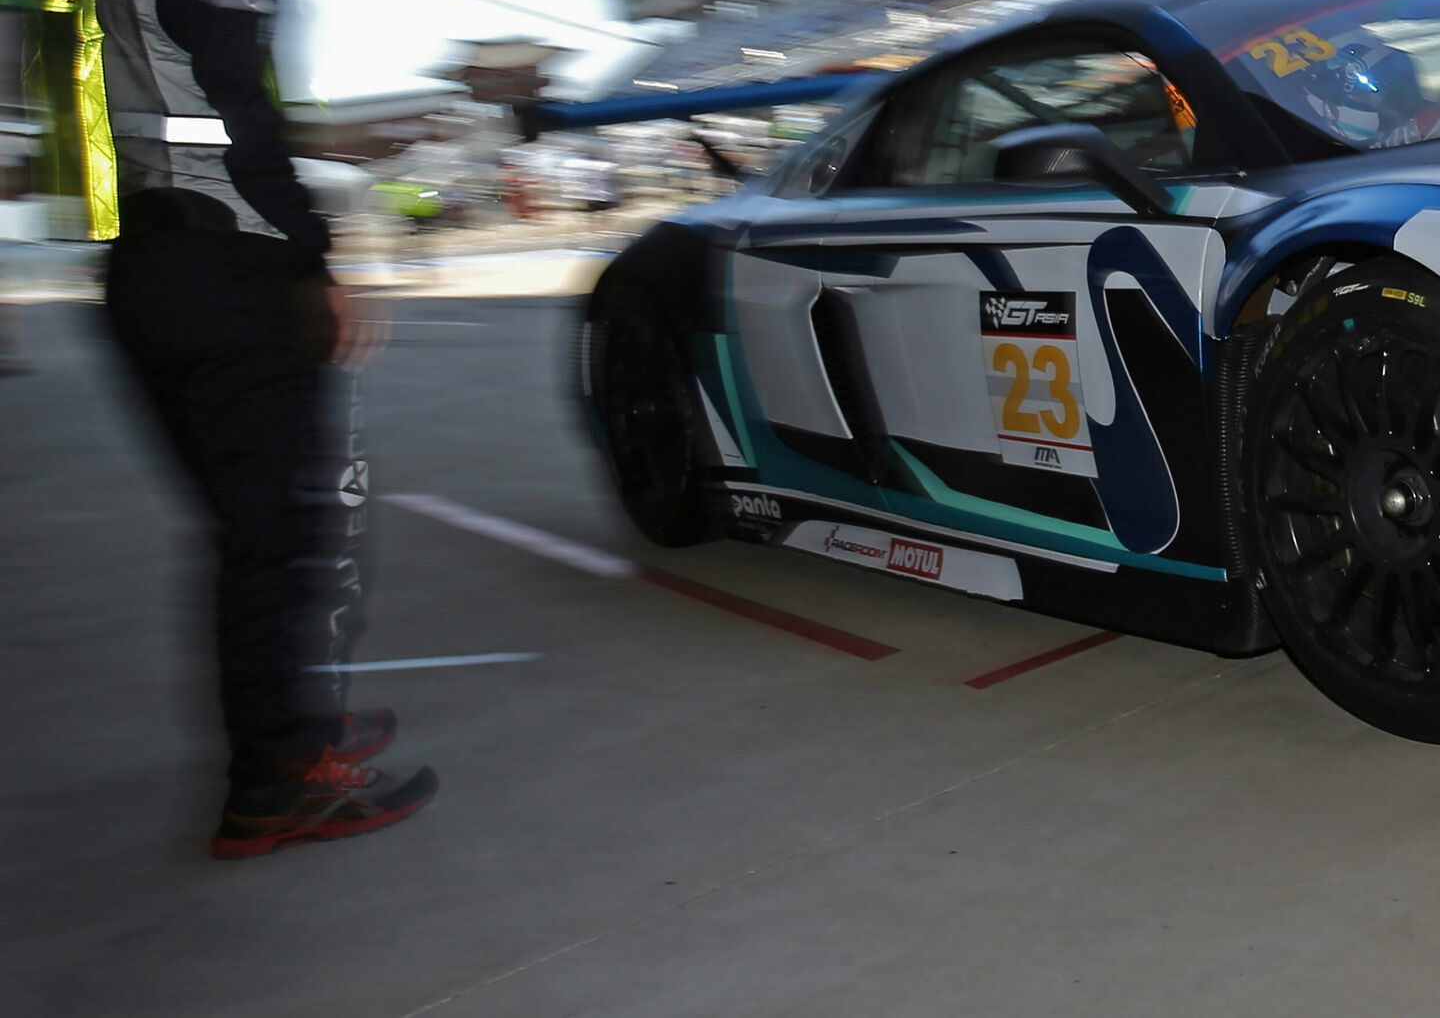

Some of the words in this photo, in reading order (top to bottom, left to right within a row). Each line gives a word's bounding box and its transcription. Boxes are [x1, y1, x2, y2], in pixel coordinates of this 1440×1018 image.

[1250, 28, 1337, 78] 23
[1001, 301, 1048, 326] GT
[1034, 313, 1069, 325] ASIA
[993, 343, 1080, 440] 23
[889, 543, 940, 575] MOTUL
